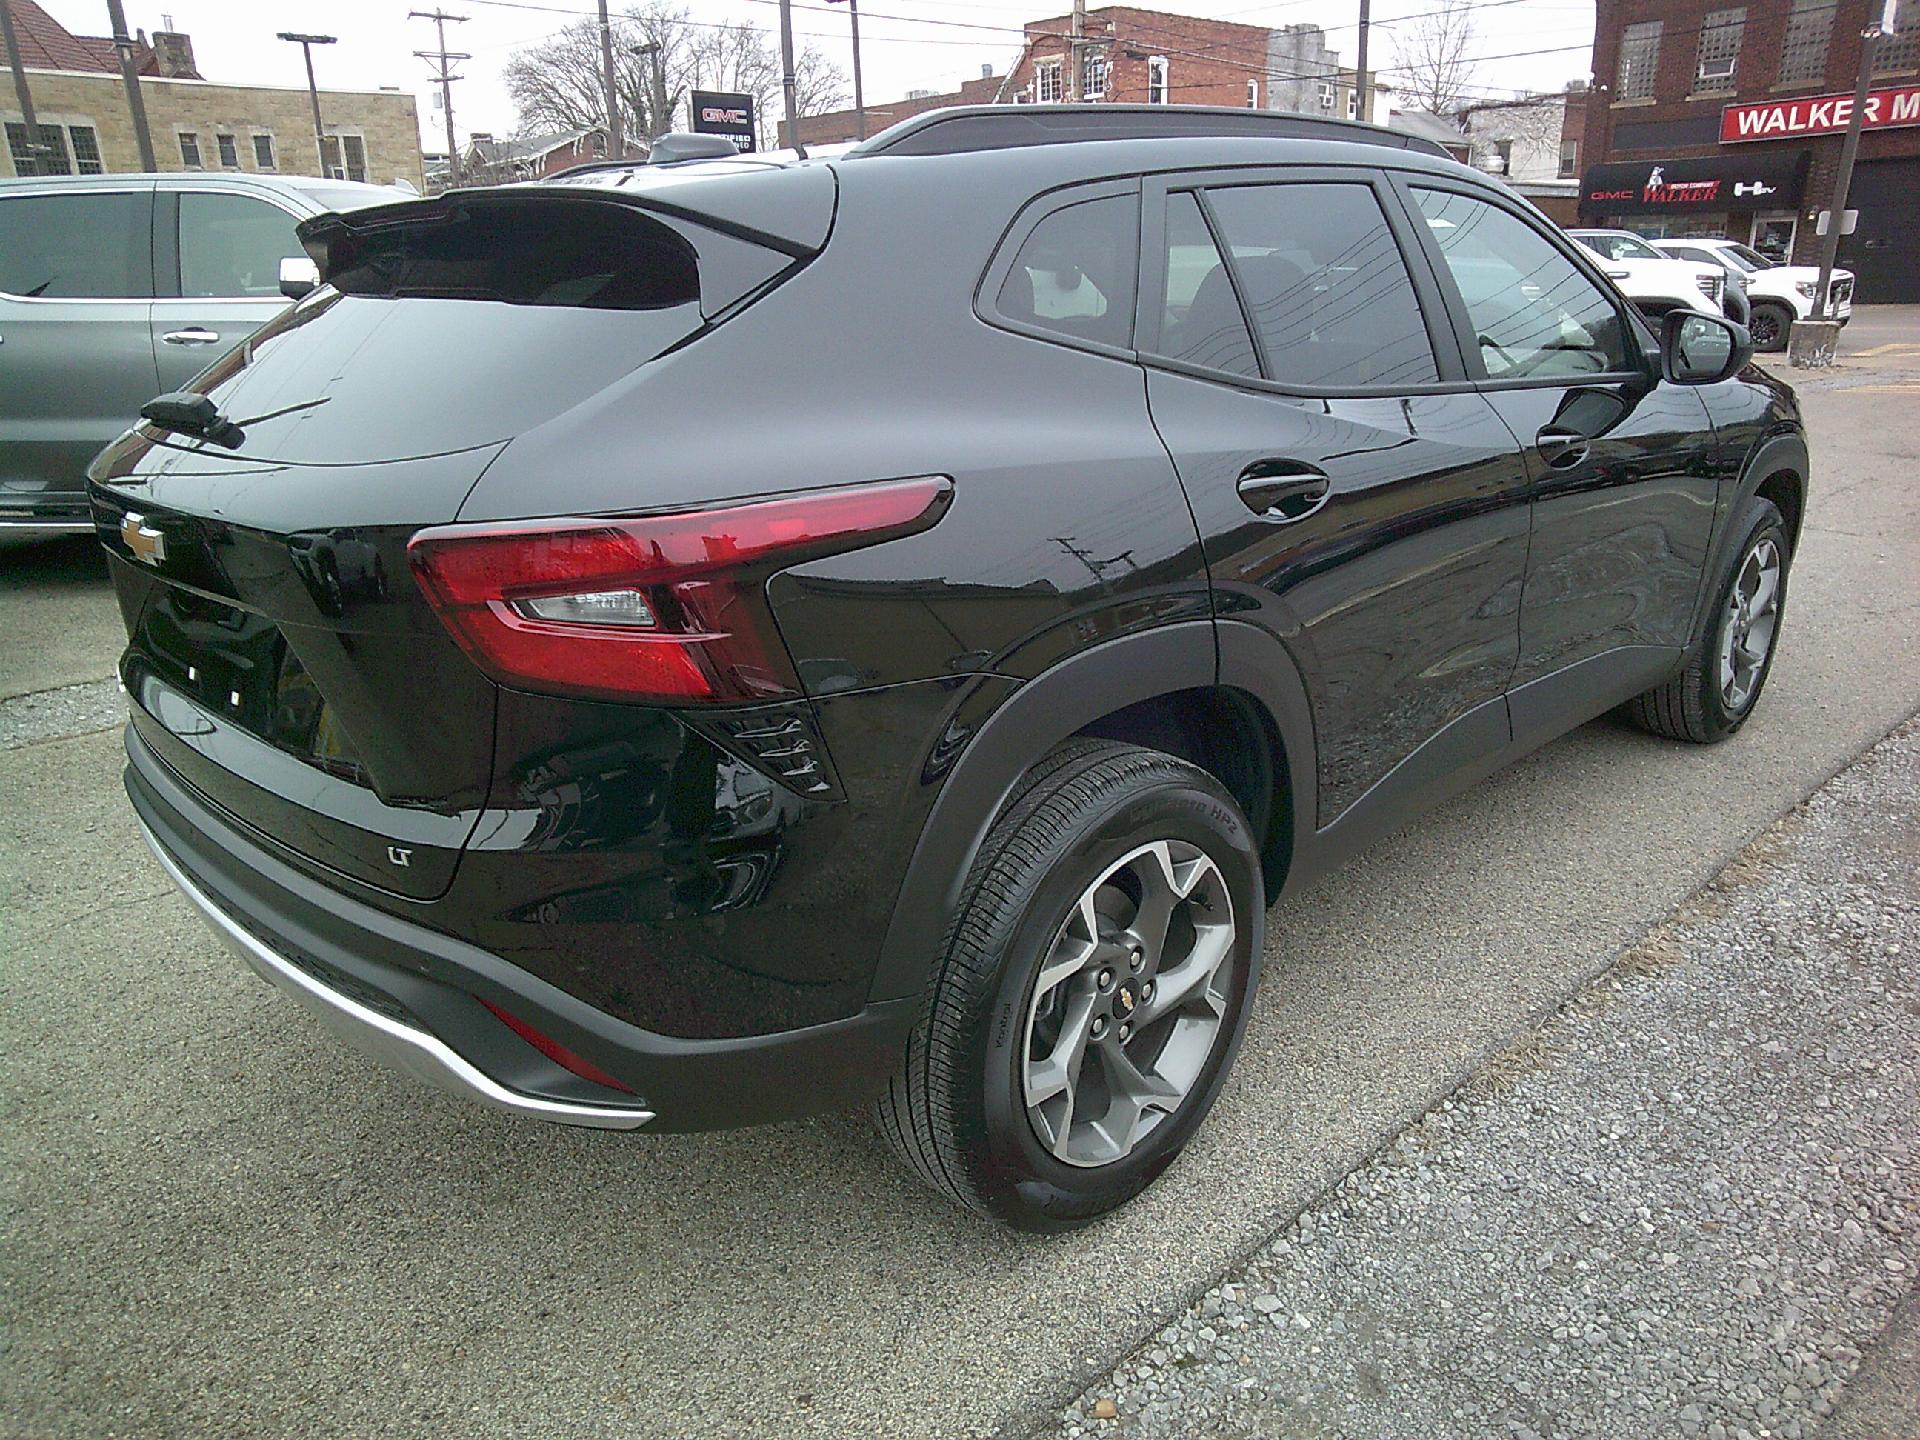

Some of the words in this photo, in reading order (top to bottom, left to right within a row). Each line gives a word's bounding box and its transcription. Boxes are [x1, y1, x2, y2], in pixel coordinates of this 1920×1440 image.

[703, 108, 748, 124] GMC
[1738, 97, 1880, 136] WALKER
[1591, 190, 1634, 200] GMC
[1643, 186, 1718, 203] WALKER
[387, 846, 413, 867] LT
